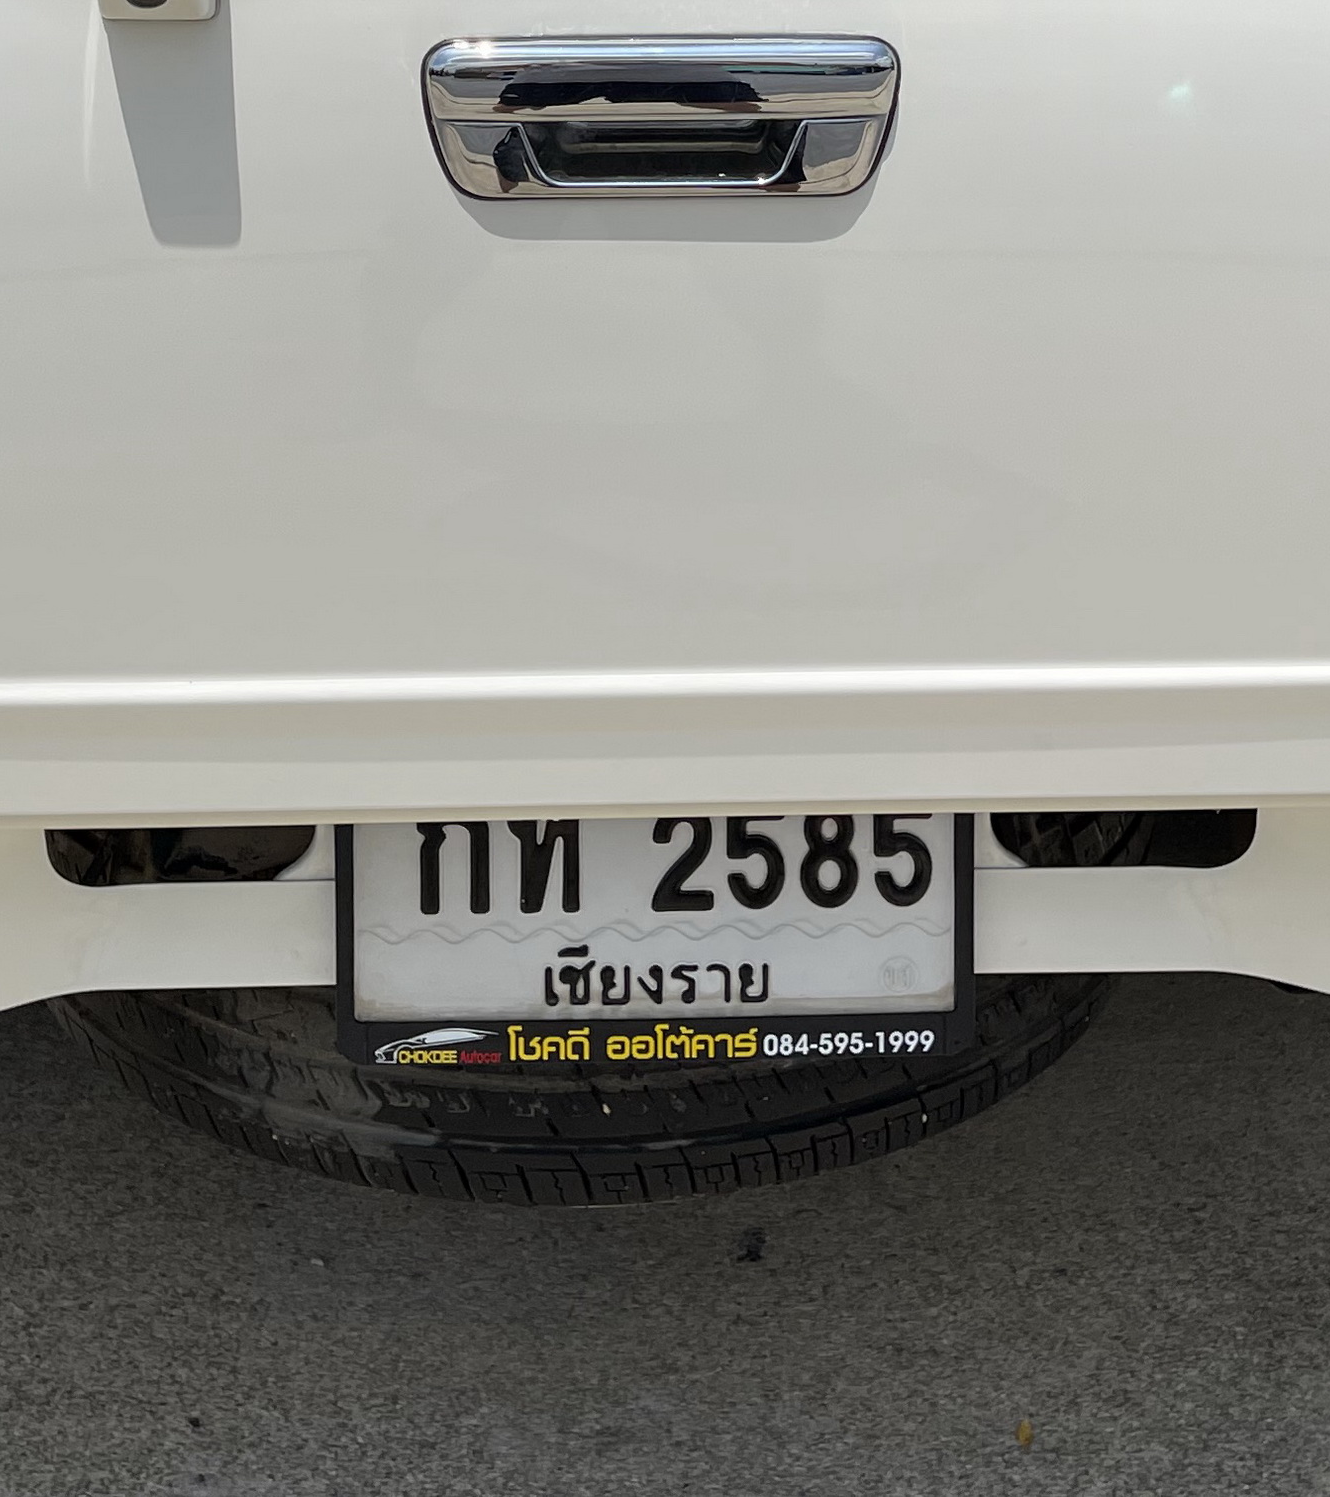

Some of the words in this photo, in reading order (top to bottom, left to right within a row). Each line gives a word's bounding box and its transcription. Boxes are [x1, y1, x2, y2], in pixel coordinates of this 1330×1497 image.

[650, 812, 933, 911] 2585
[544, 944, 770, 1006] เชียงราย
[398, 1049, 458, 1064] CHOKDEE
[459, 1049, 502, 1063] Autocar
[507, 1025, 591, 1061] โชคดี
[606, 1025, 759, 1060] ออโต้คาร์
[763, 1030, 935, 1056] 084-595-1999
